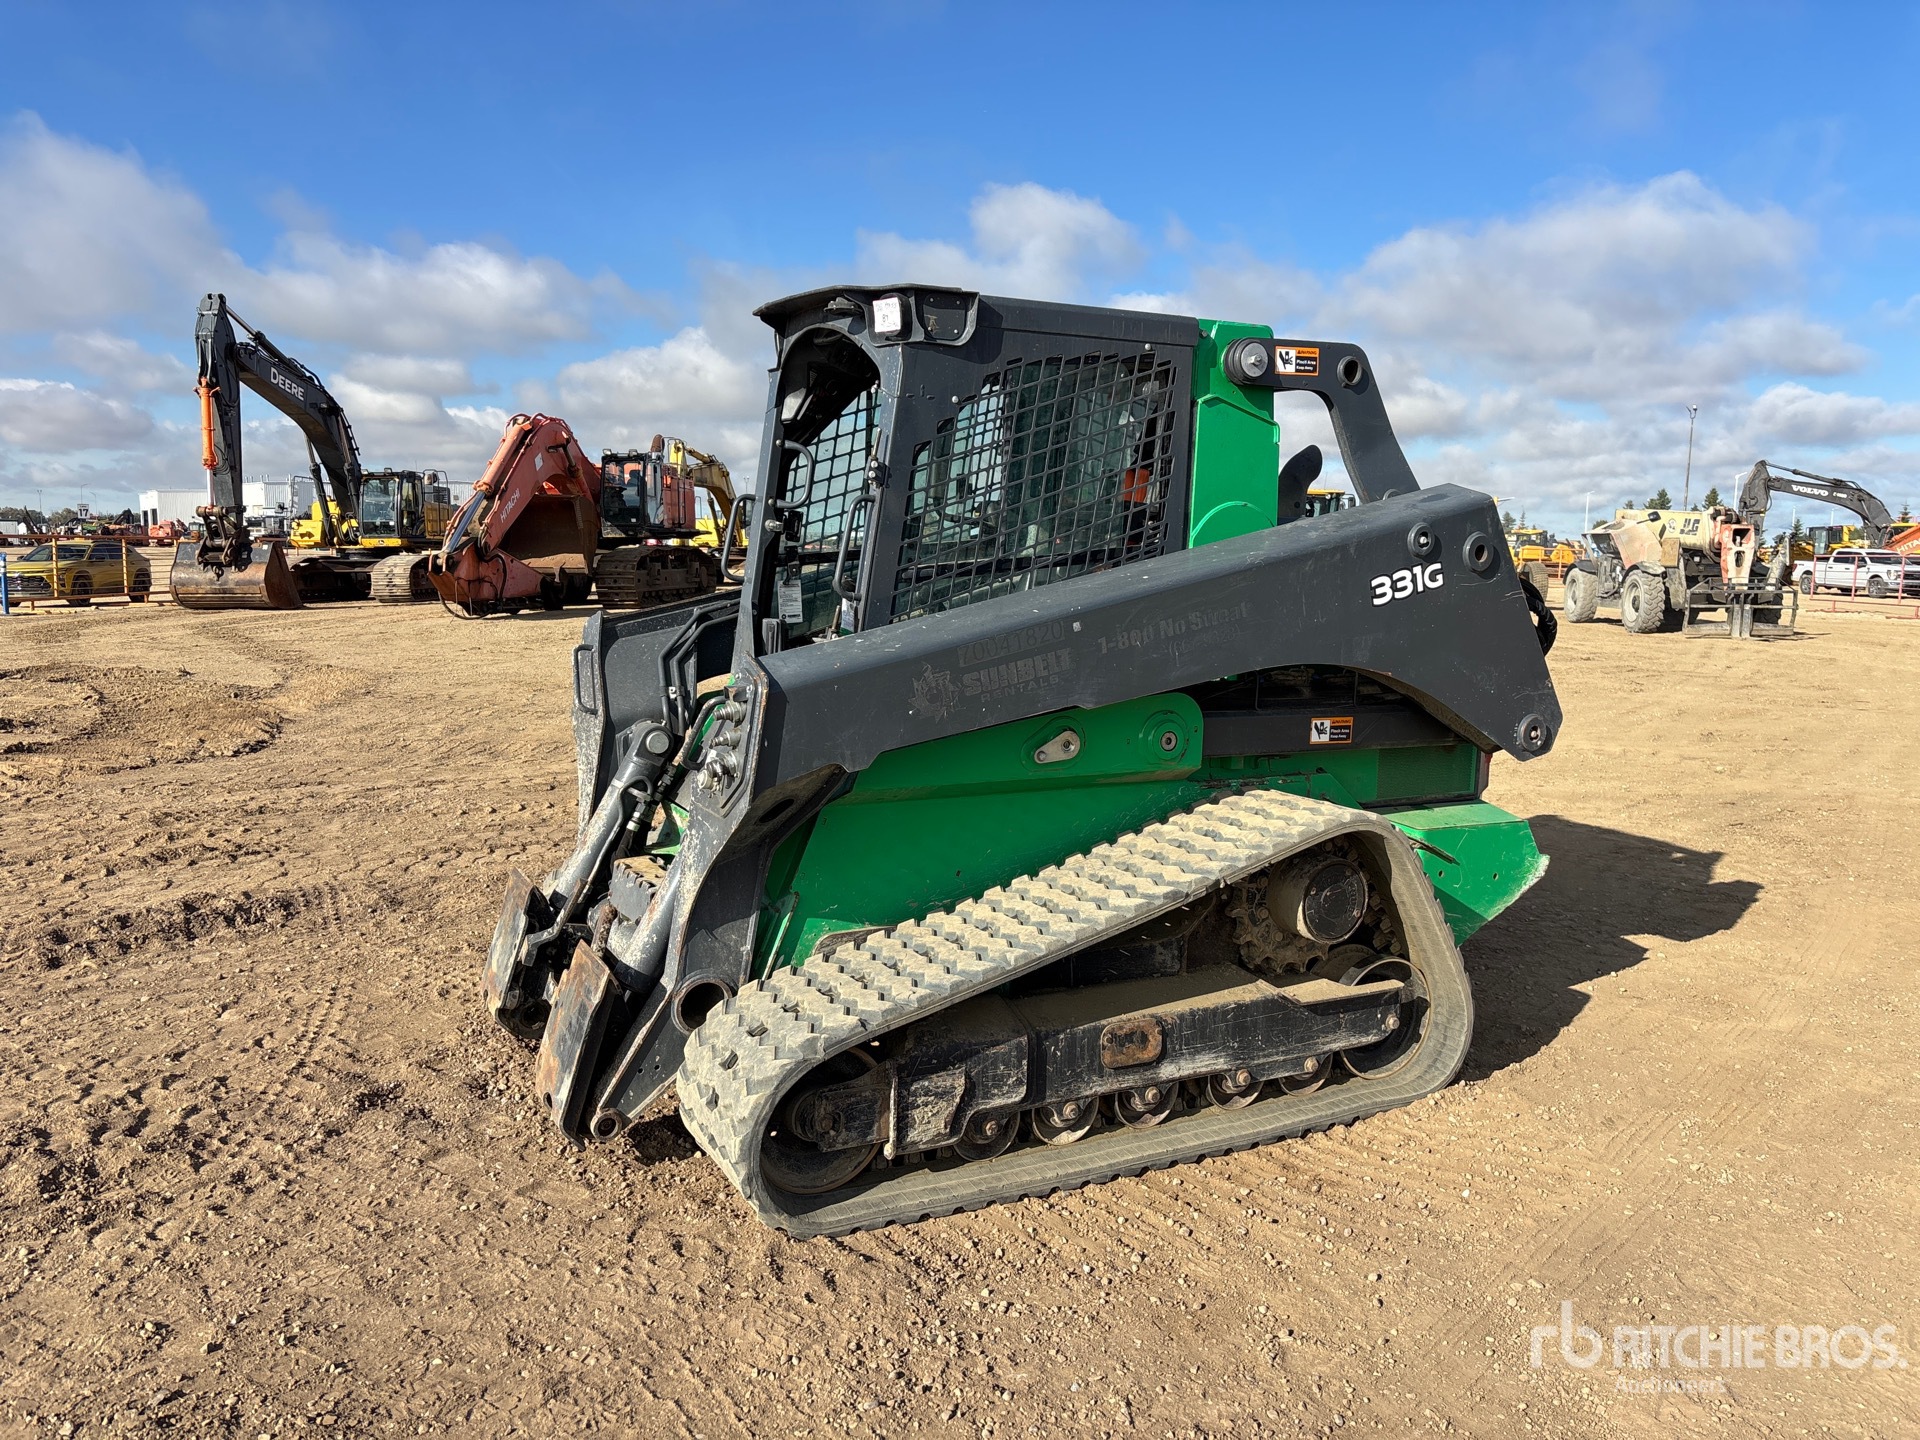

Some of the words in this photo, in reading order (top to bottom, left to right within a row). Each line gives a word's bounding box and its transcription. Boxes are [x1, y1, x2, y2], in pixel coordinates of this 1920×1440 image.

[270, 366, 305, 401] DEERE
[500, 487, 521, 524] HITACHI
[1791, 484, 1829, 497] VOLVO
[79, 508, 89, 517] 17
[1370, 561, 1444, 607] 331G
[960, 620, 1064, 665] 70041820
[1159, 617, 1186, 640] No
[961, 647, 1073, 697] SUNBELT
[980, 675, 1060, 703] RENTALS
